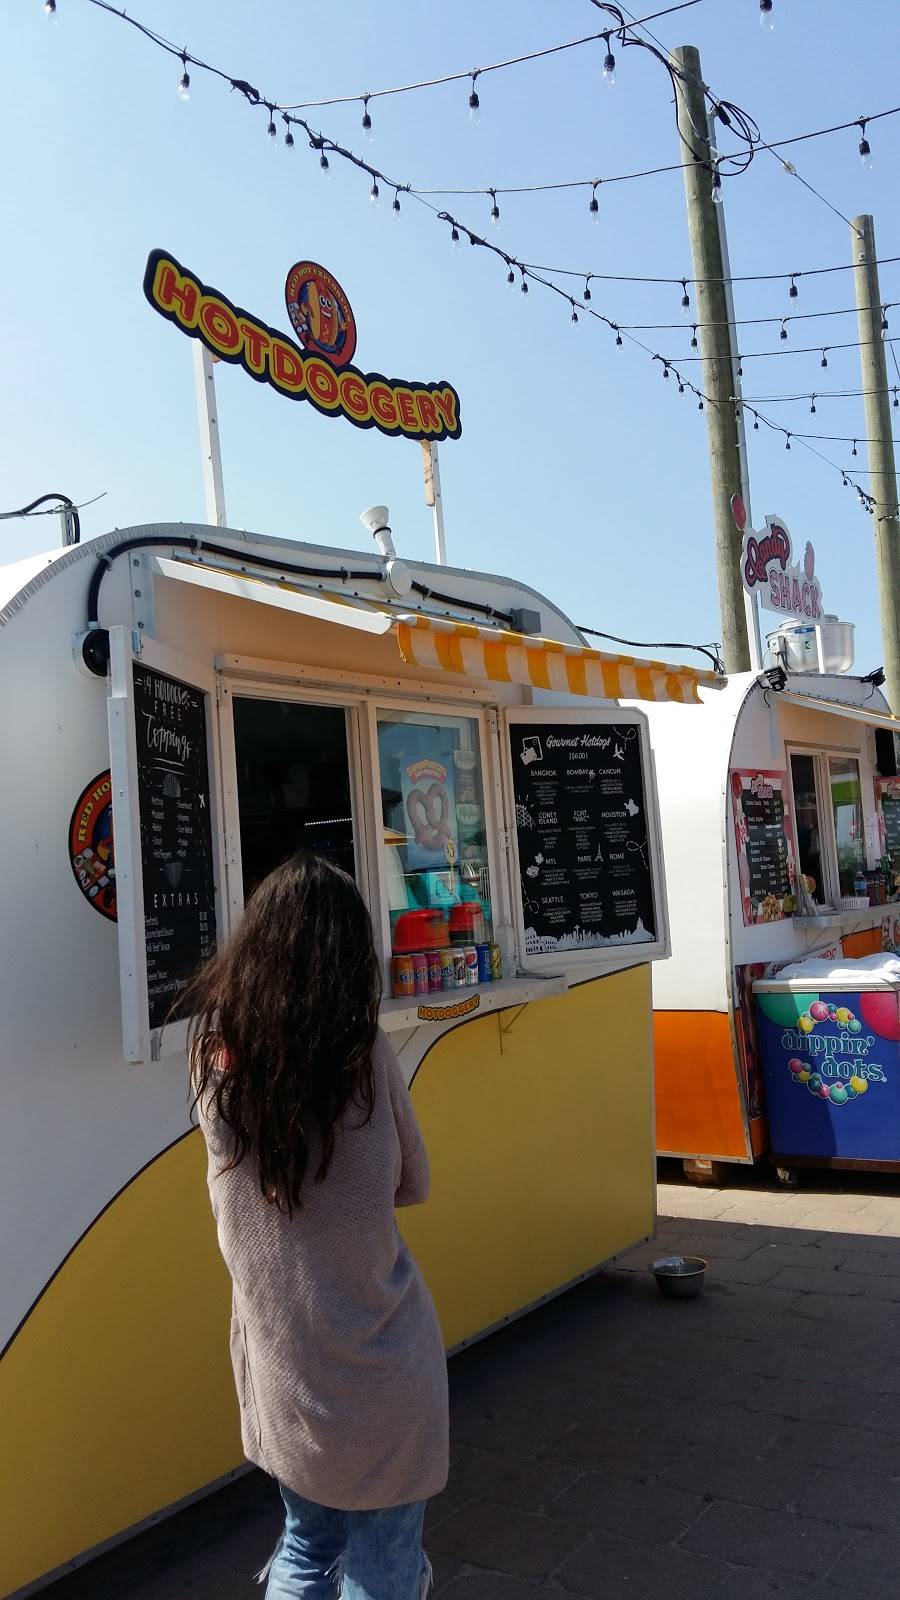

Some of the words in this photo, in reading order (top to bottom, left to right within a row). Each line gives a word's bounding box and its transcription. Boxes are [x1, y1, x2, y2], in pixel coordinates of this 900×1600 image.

[289, 275, 299, 297] RED
[298, 266, 312, 277] HOT
[154, 261, 457, 432] HOTDOGGERY
[769, 569, 821, 619] SHACK
[154, 679, 182, 705] HOTDOGS
[154, 701, 182, 721] FREE
[142, 709, 194, 762] Toppings
[545, 735, 580, 749] Gourmet
[580, 734, 612, 749] Hotdogs
[78, 800, 94, 843] RED
[538, 811, 557, 819] CONEY
[601, 811, 627, 819] HOUSTON
[577, 855, 592, 863] PARIS
[609, 852, 625, 860] ROME
[154, 892, 204, 908] EXTRAS
[541, 896, 565, 904] SEATTLE
[579, 892, 599, 900] TOKYO
[611, 889, 635, 897] WASAGA
[418, 995, 480, 1020] HOTDOGGERY
[781, 1028, 875, 1056] dippin'
